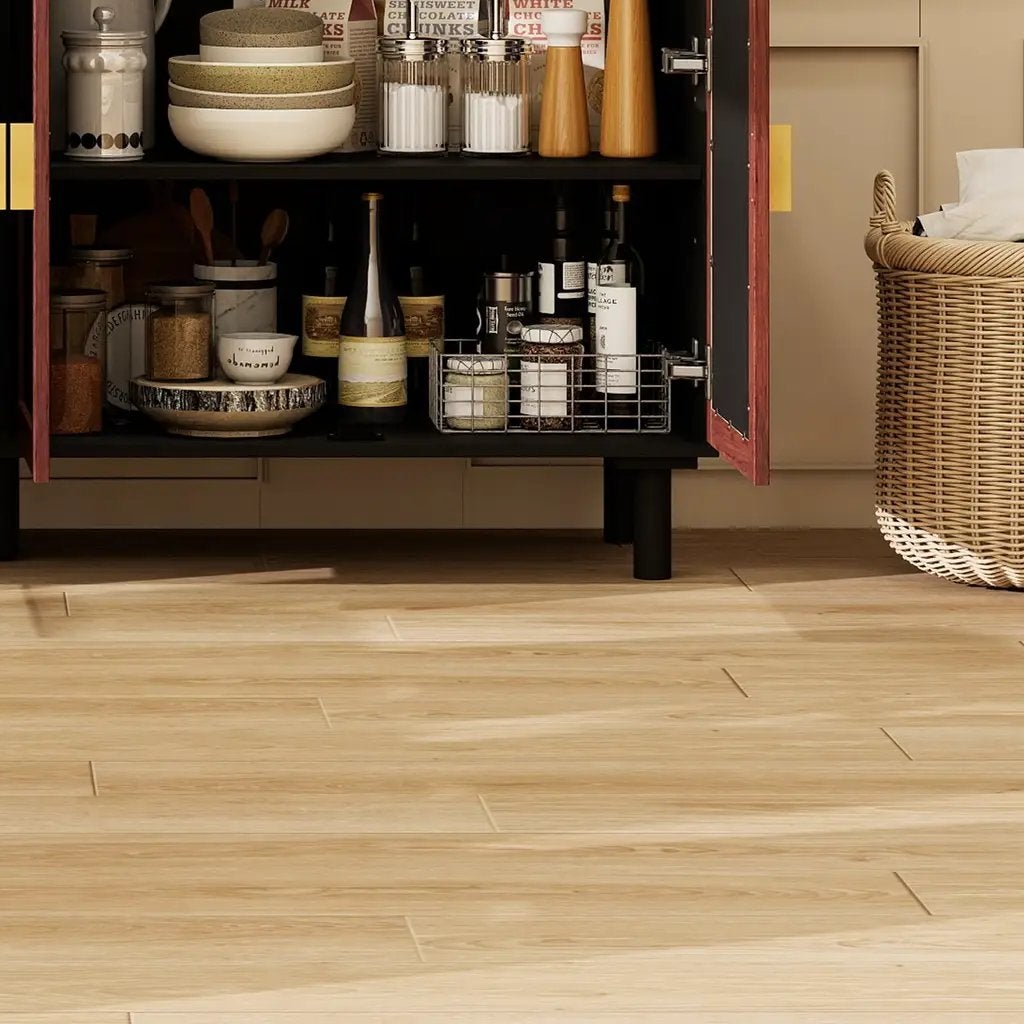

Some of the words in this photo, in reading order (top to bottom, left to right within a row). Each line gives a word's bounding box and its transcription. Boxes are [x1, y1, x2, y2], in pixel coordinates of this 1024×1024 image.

[388, 0, 475, 9] SEISWEET
[513, 0, 574, 9] WHITE
[388, 11, 475, 20] CHCOLATE
